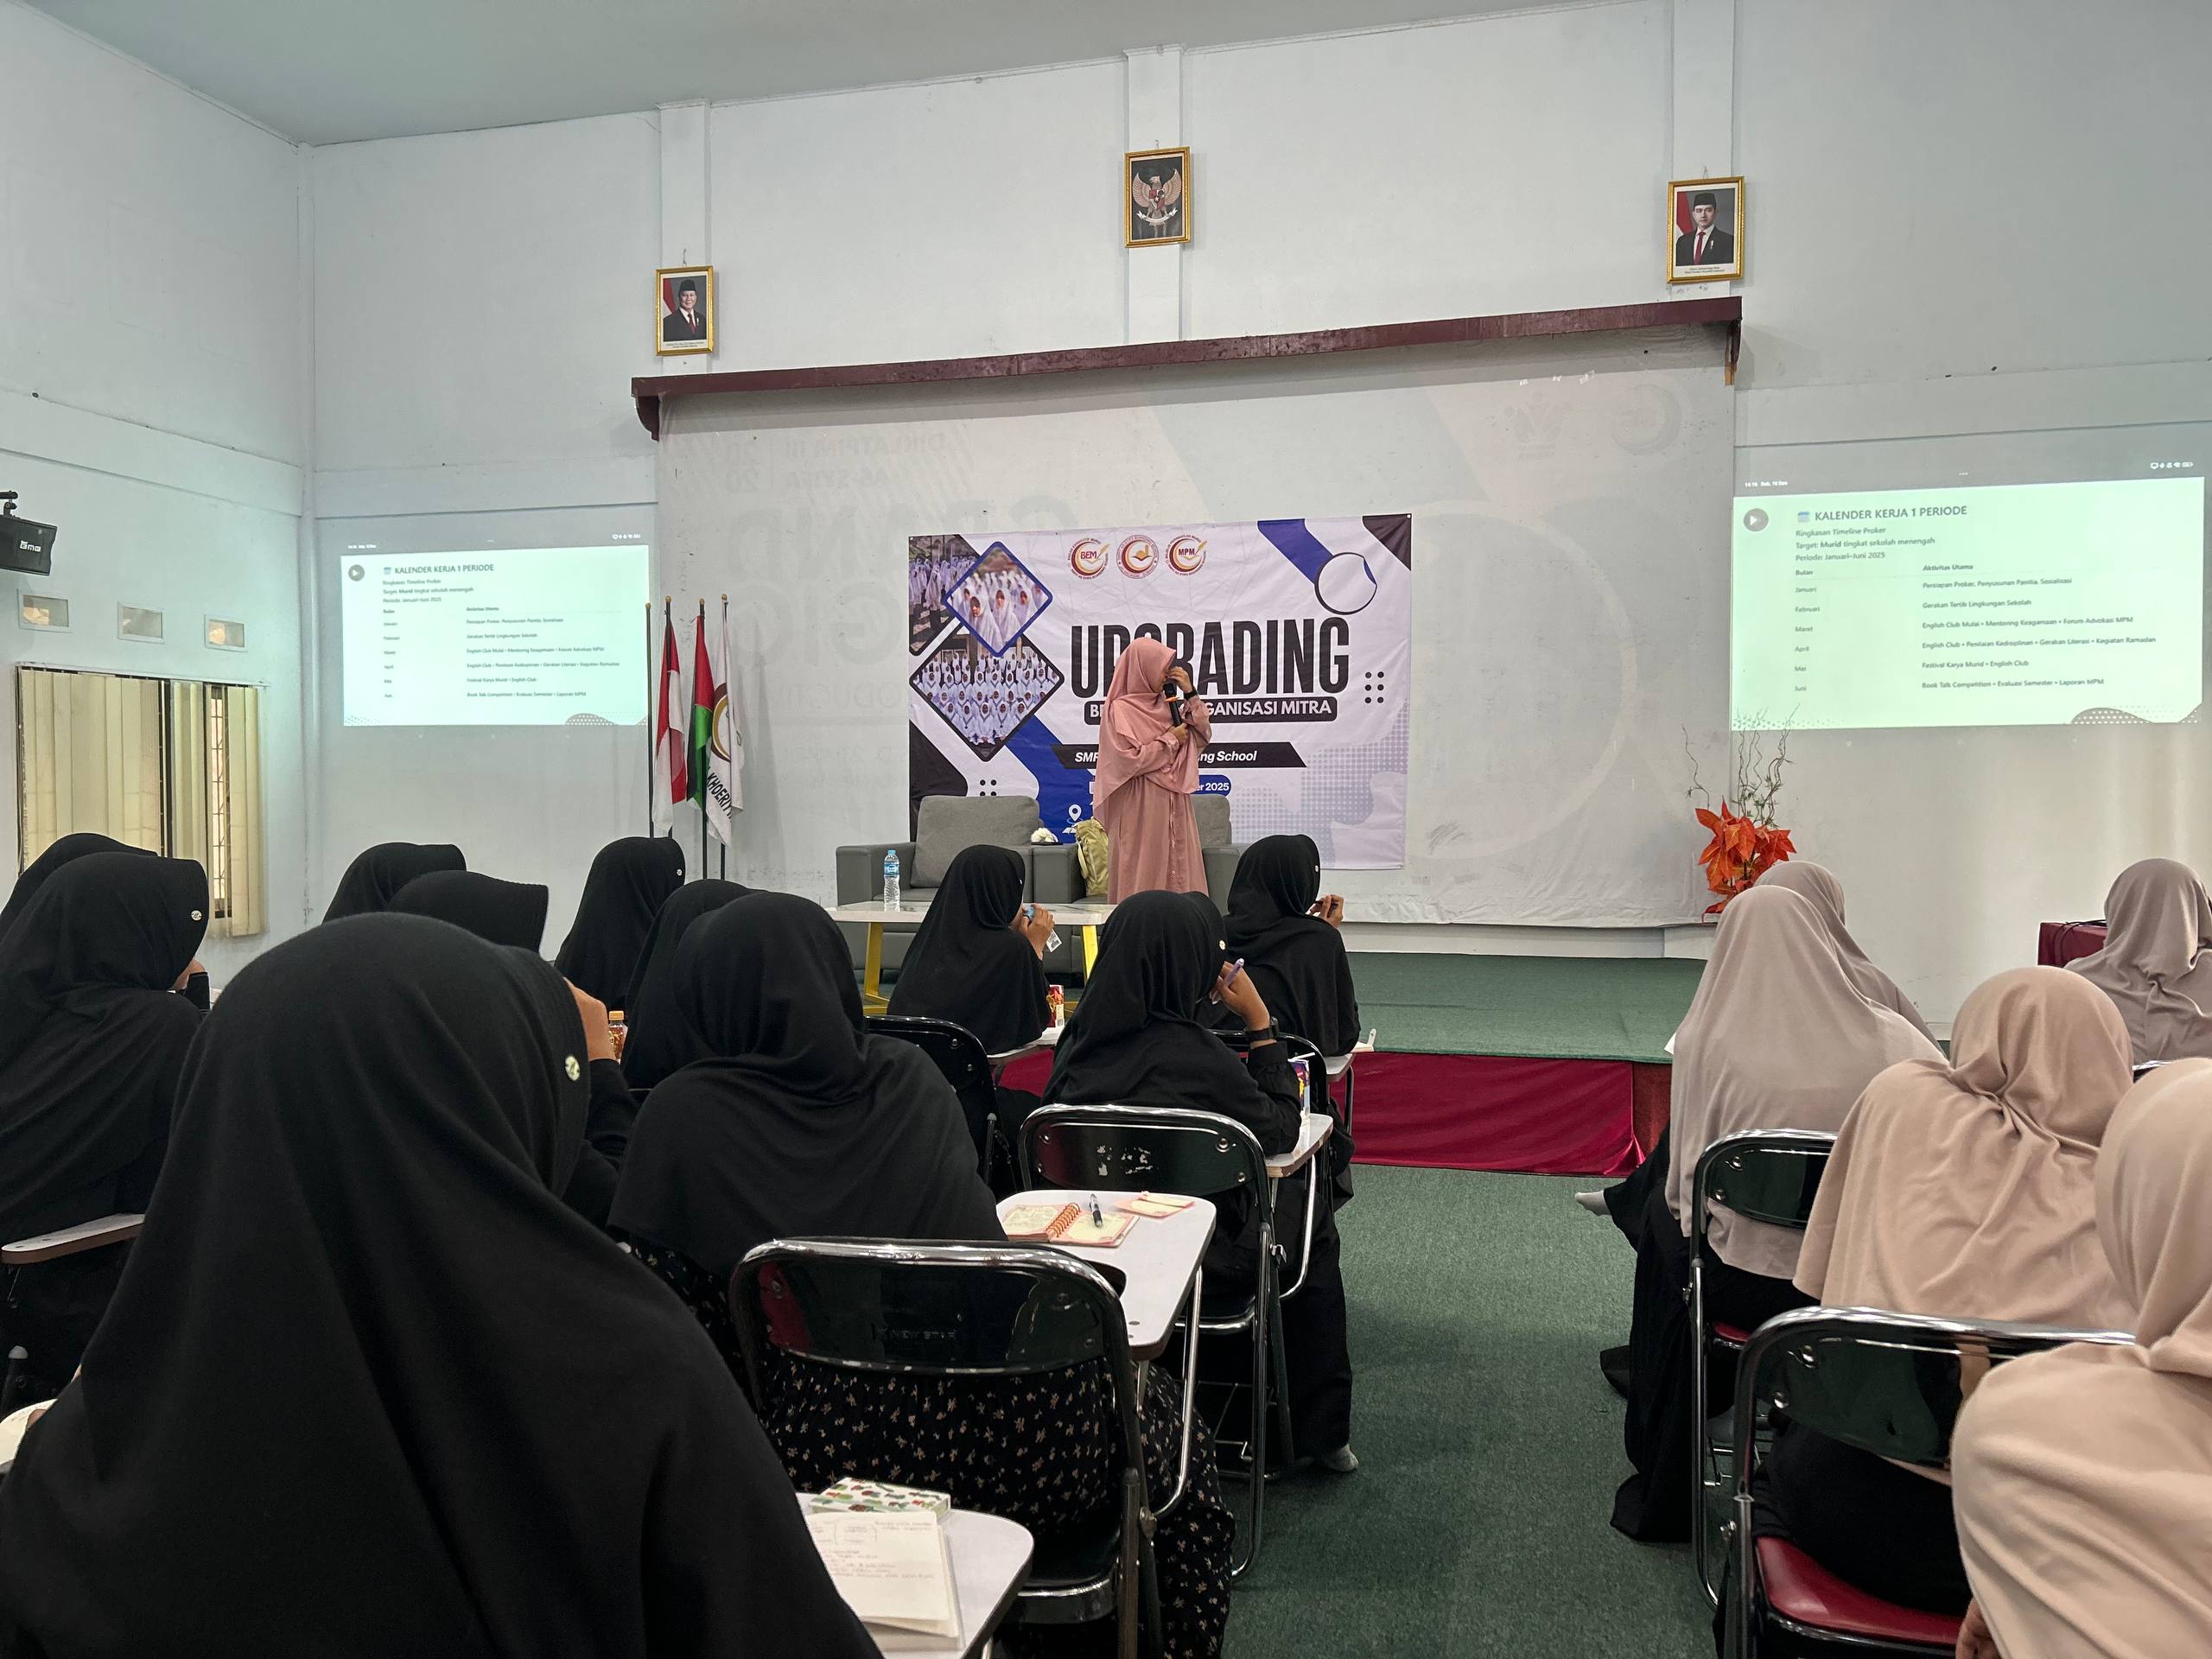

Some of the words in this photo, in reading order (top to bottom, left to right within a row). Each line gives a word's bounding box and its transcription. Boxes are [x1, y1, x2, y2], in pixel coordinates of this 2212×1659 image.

[1815, 510, 1872, 521] KALENDER
[1875, 508, 1908, 519] KERJA
[1911, 508, 1916, 517] 1
[1920, 505, 1967, 517] PERIODE
[1796, 530, 1830, 538] Ringkasan
[1843, 540, 1867, 549] tingkat
[1897, 537, 1936, 546] menengah
[1071, 617, 1350, 698] UPRADING
[1281, 699, 1332, 715] MITRA
[1217, 750, 1257, 762] School
[1205, 782, 1230, 791] 2025
